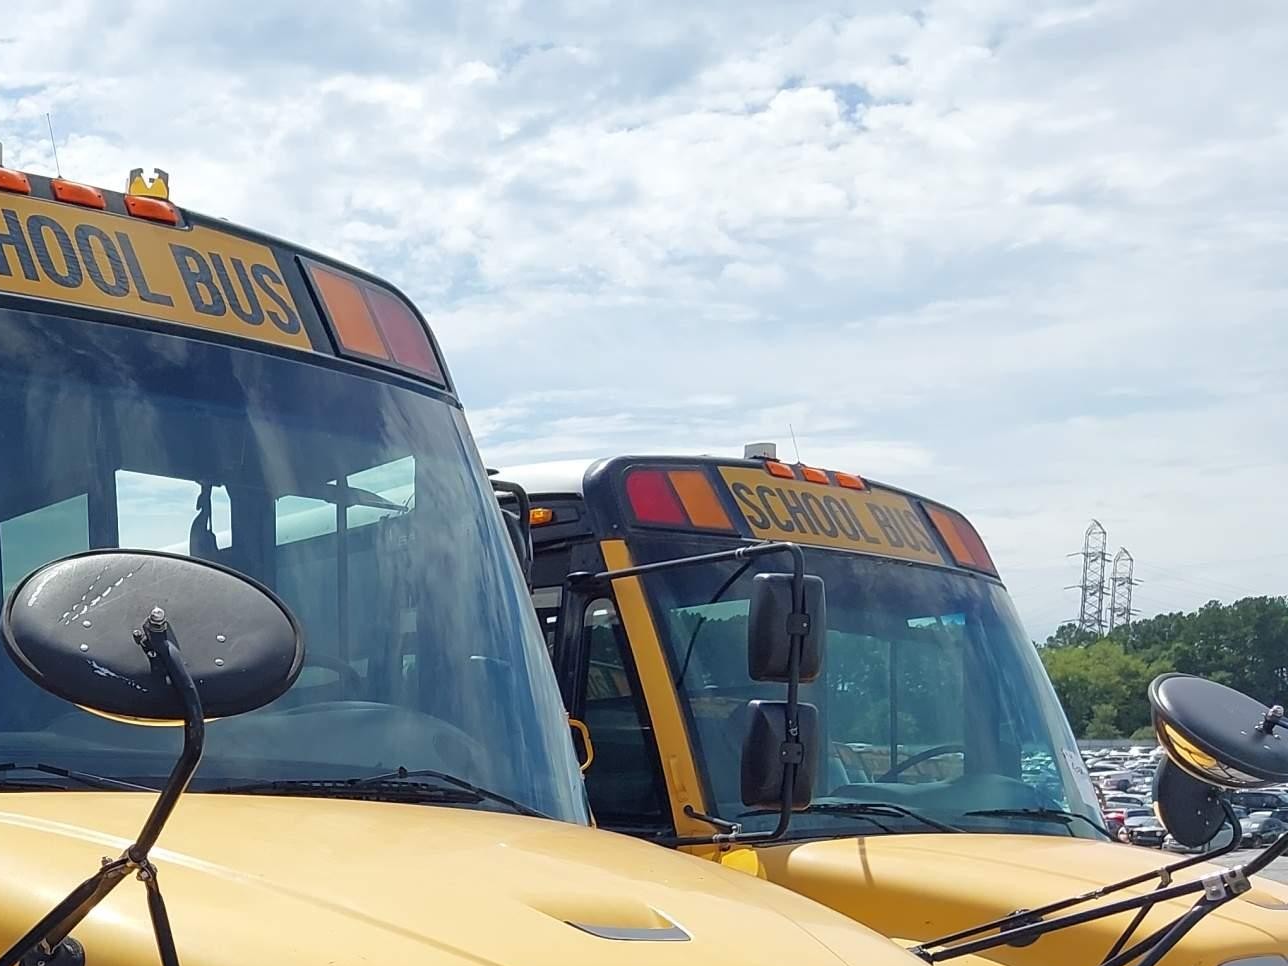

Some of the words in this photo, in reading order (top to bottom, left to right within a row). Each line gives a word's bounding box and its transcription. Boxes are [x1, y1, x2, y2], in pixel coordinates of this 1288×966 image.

[168, 243, 301, 335] BUS
[731, 482, 880, 544] SCHOOL
[866, 502, 936, 554] BUS
